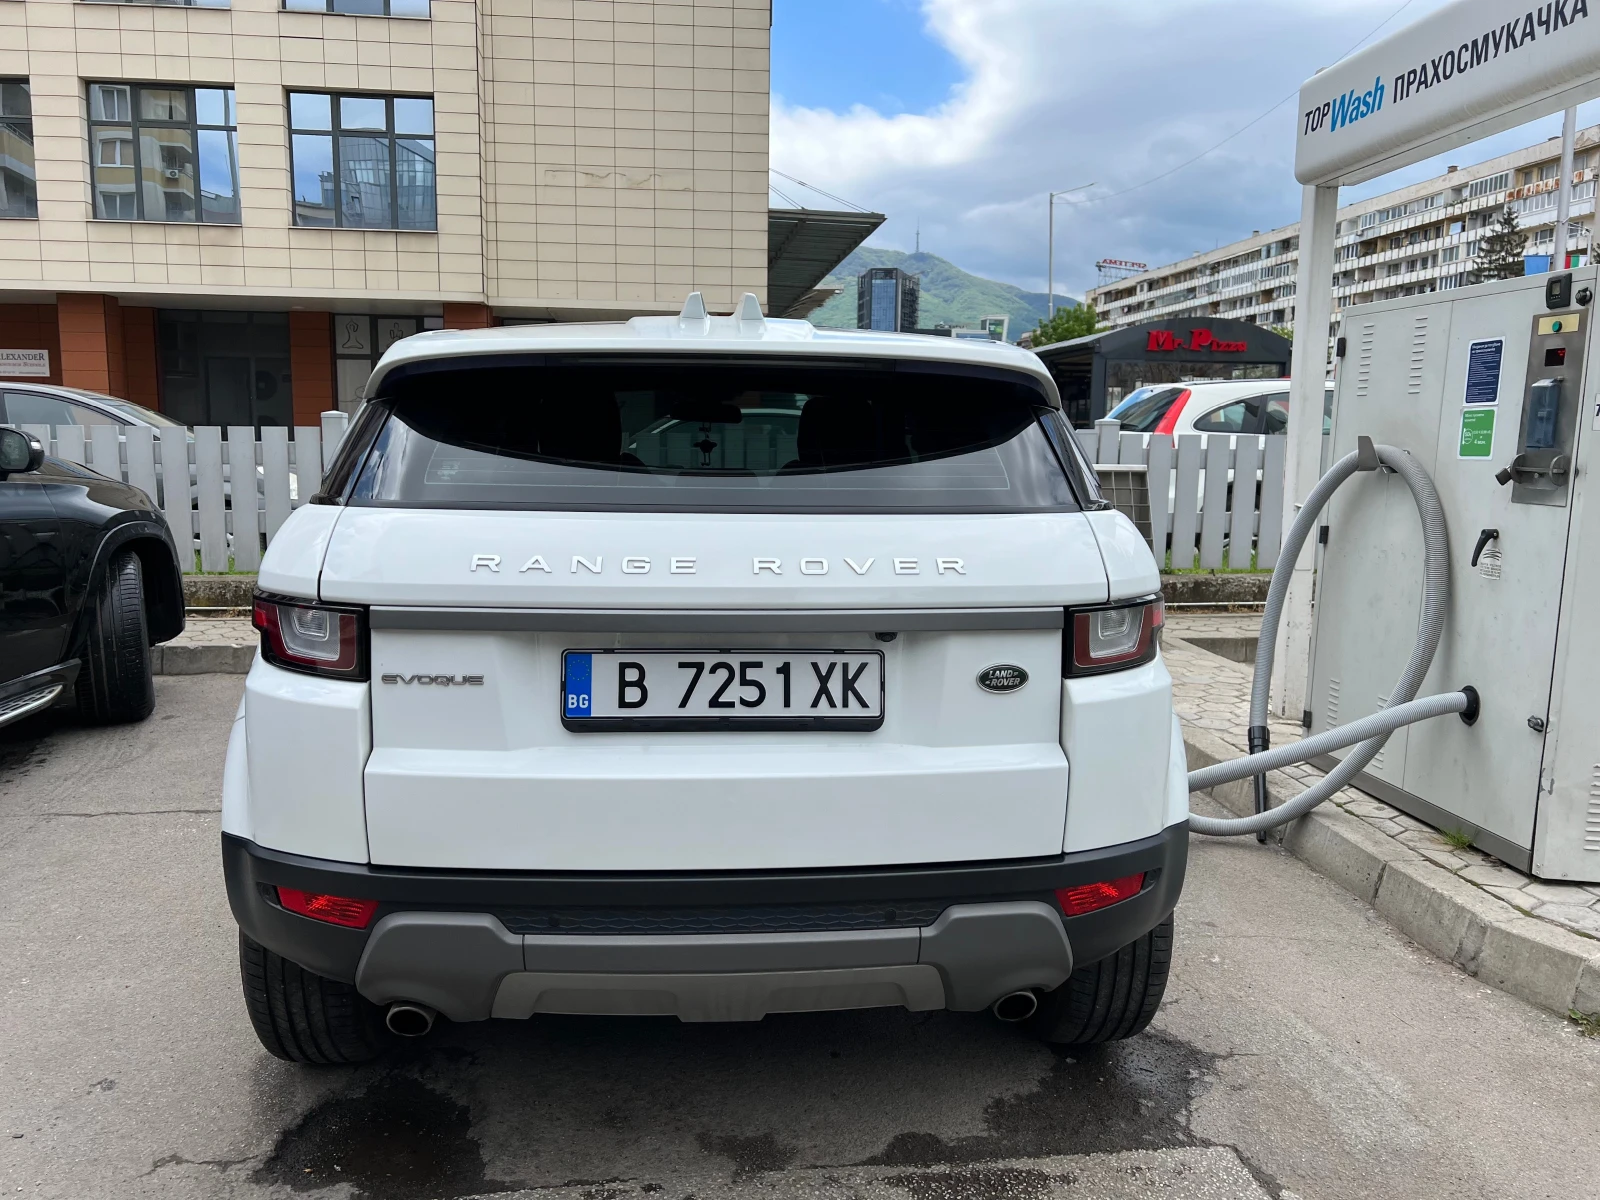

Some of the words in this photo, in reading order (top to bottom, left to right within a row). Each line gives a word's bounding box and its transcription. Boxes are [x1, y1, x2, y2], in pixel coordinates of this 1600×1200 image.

[1393, 0, 1588, 103] ПРАХОСМУКАЧКА
[0, 353, 45, 361] LEXANDER
[470, 554, 698, 574] RANGE
[752, 557, 967, 575] ROVER
[381, 673, 485, 686] EVOQUE
[988, 670, 1013, 679] LAND
[990, 677, 1021, 686] ROVER
[618, 661, 648, 709] B
[678, 661, 791, 709] 7251
[810, 661, 870, 709] XK
[567, 694, 589, 709] BG
